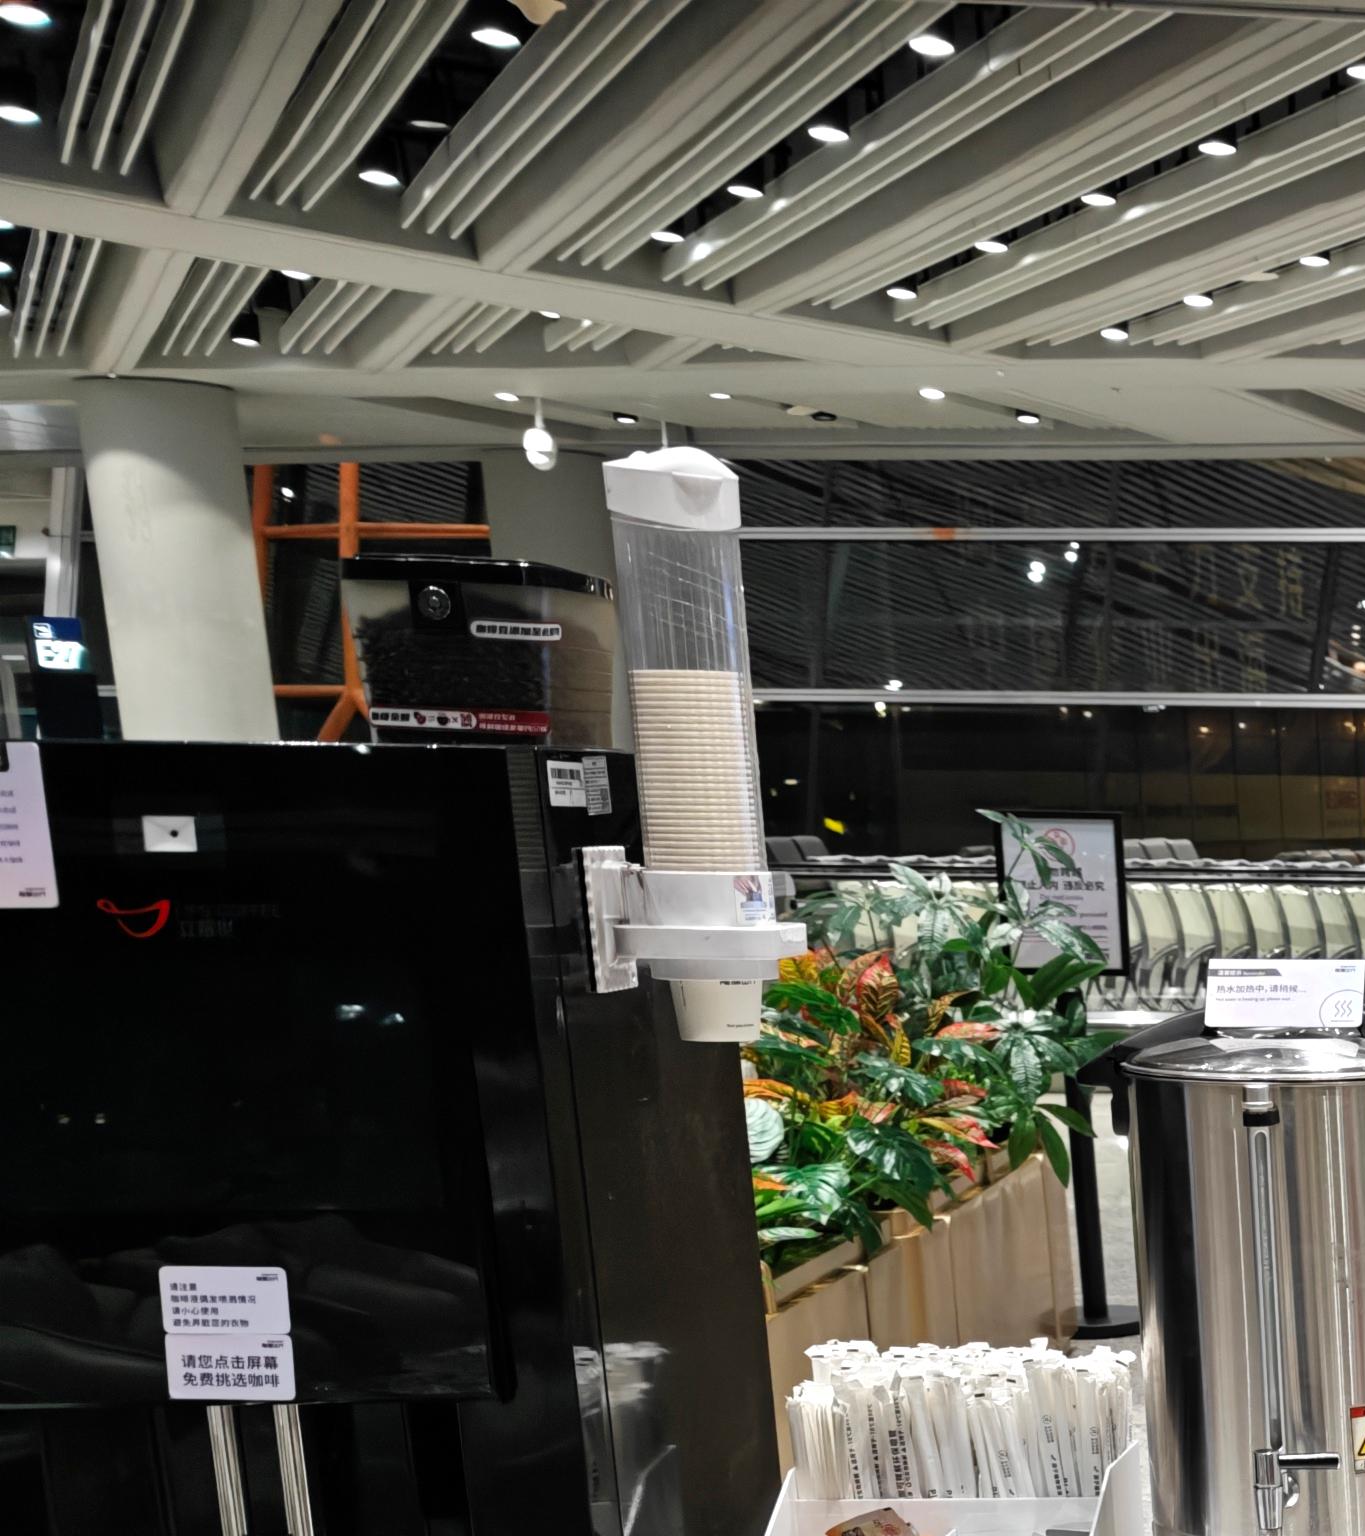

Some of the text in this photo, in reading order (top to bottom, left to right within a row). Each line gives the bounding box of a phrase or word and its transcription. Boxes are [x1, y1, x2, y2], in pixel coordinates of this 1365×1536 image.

[181, 1355, 278, 1370] 请您点击屏幕
[183, 1372, 280, 1387] 免费挑选咖啡
